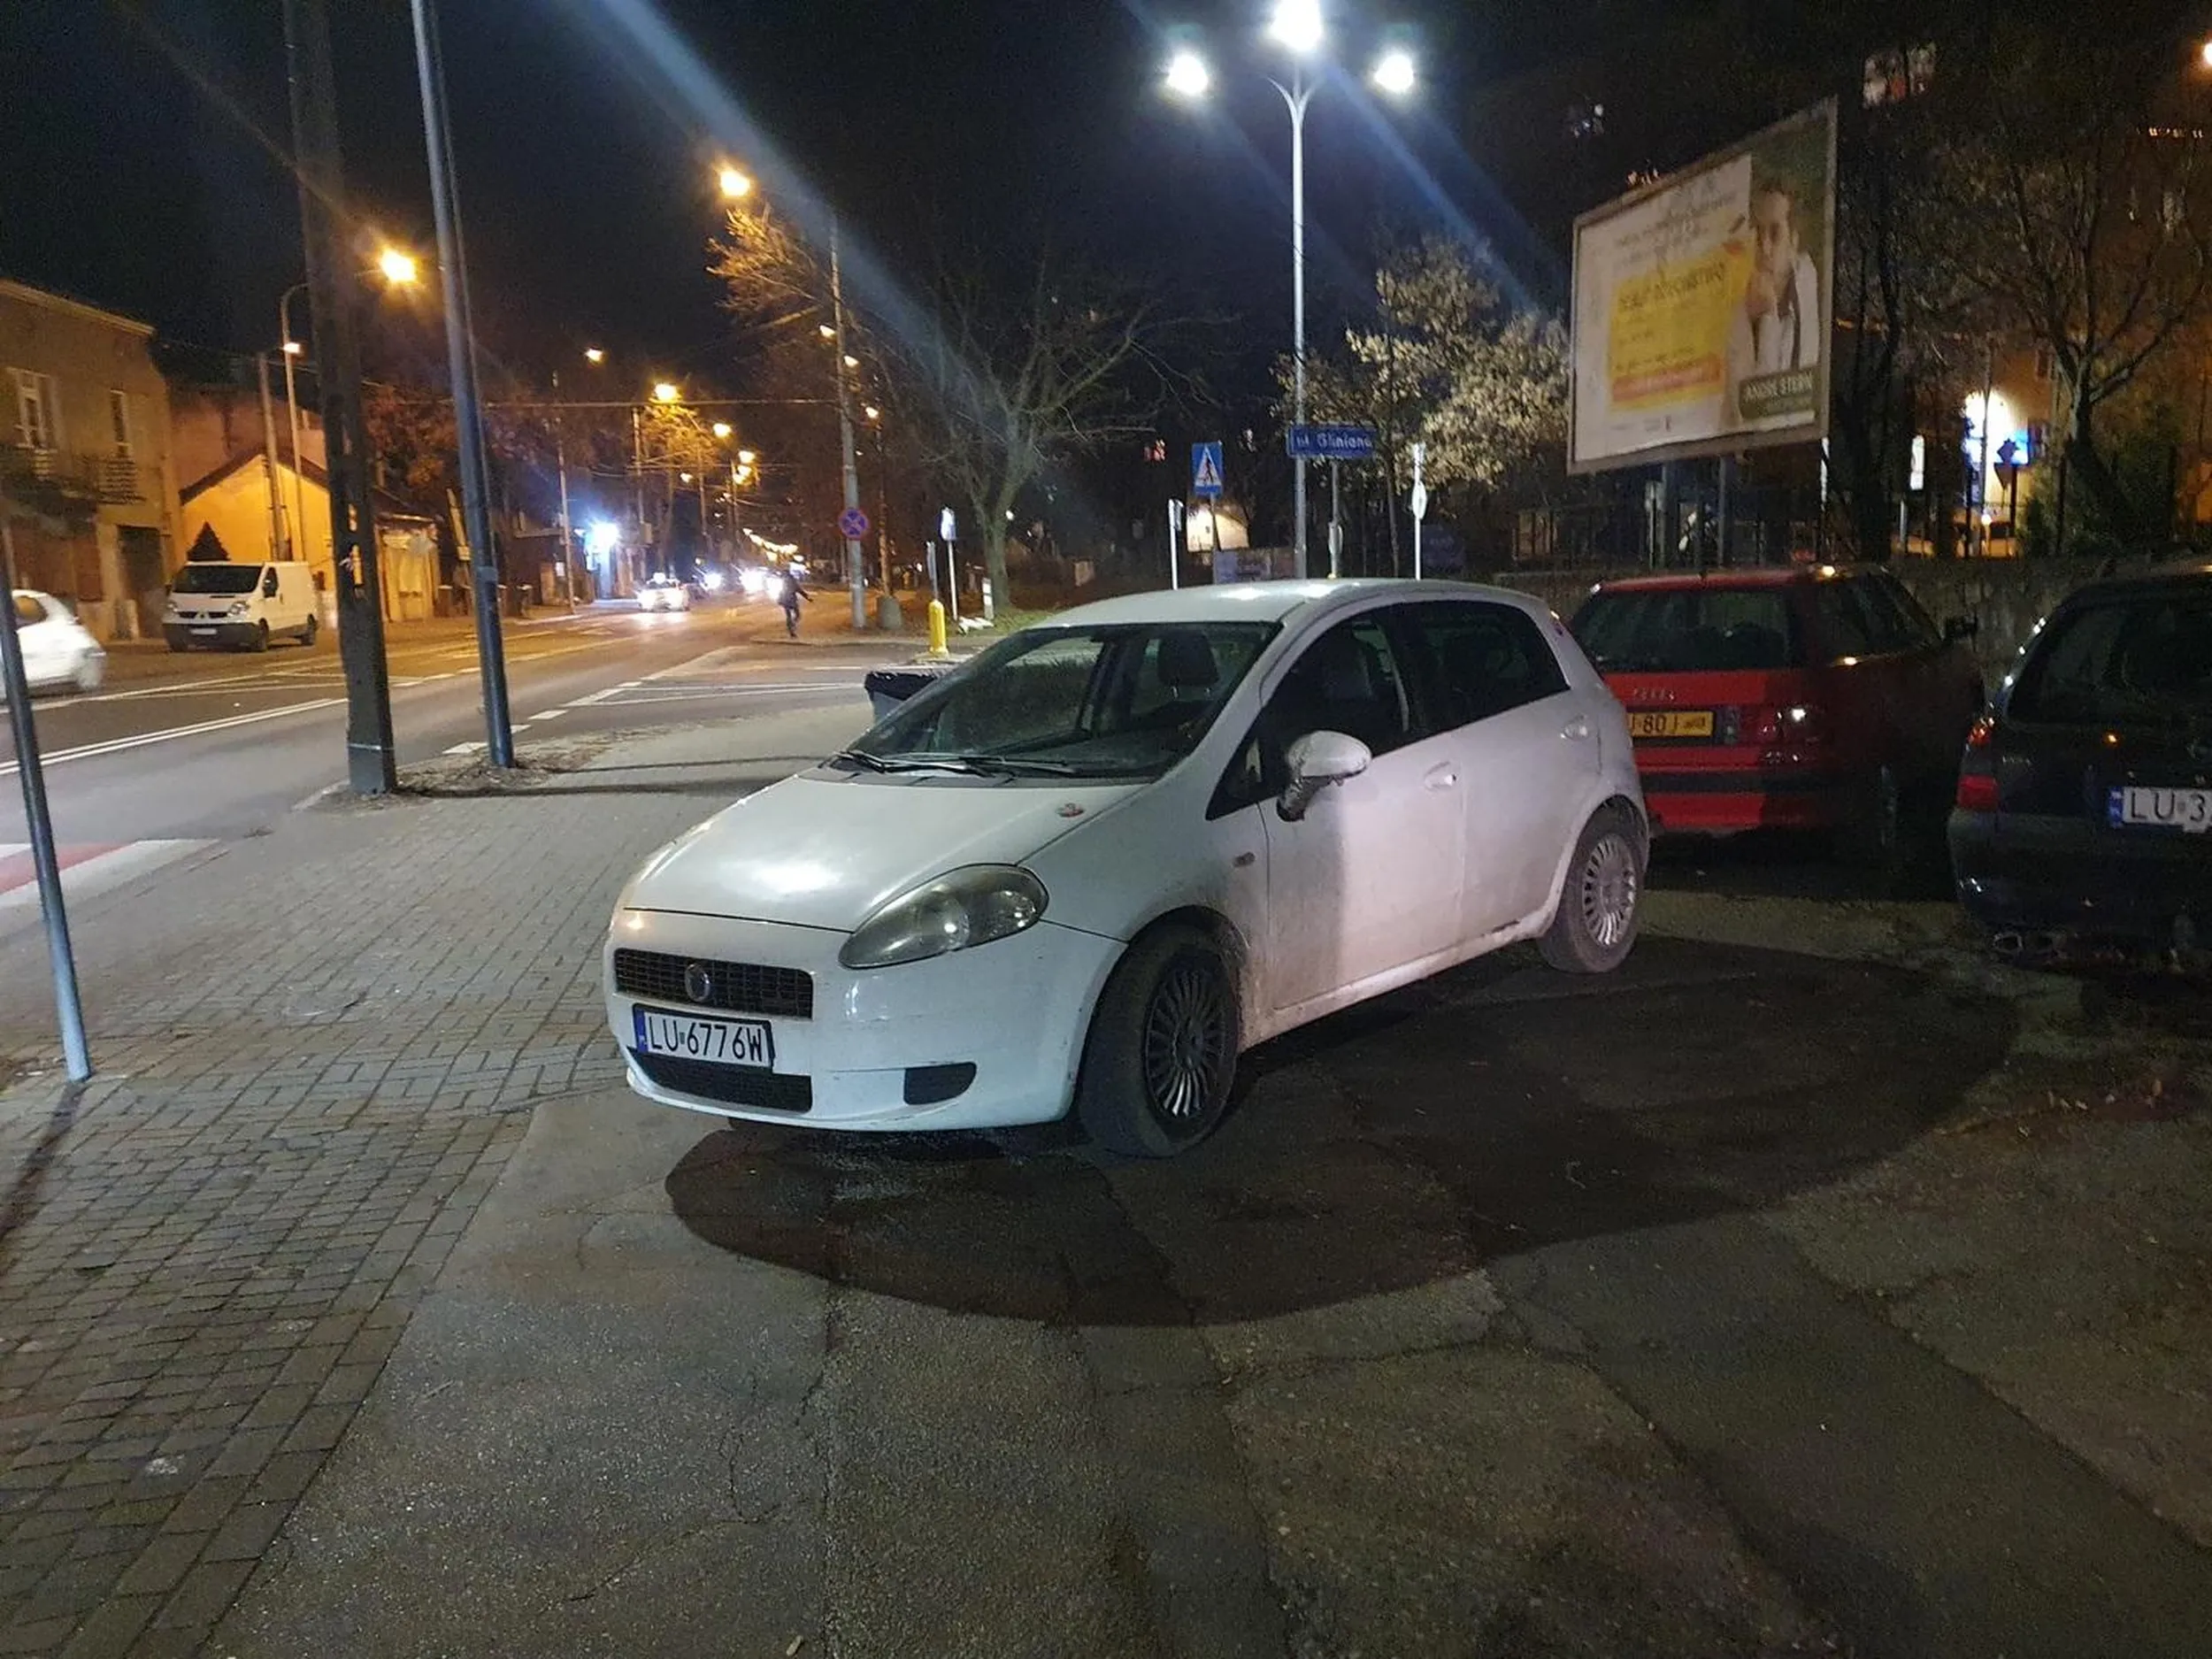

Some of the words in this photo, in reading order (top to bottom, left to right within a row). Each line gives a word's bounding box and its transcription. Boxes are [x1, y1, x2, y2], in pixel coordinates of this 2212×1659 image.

[2131, 790, 2176, 820] LU
[2189, 793, 2212, 823] 3
[648, 1017, 679, 1052] LU
[687, 1021, 763, 1062] 6776W
